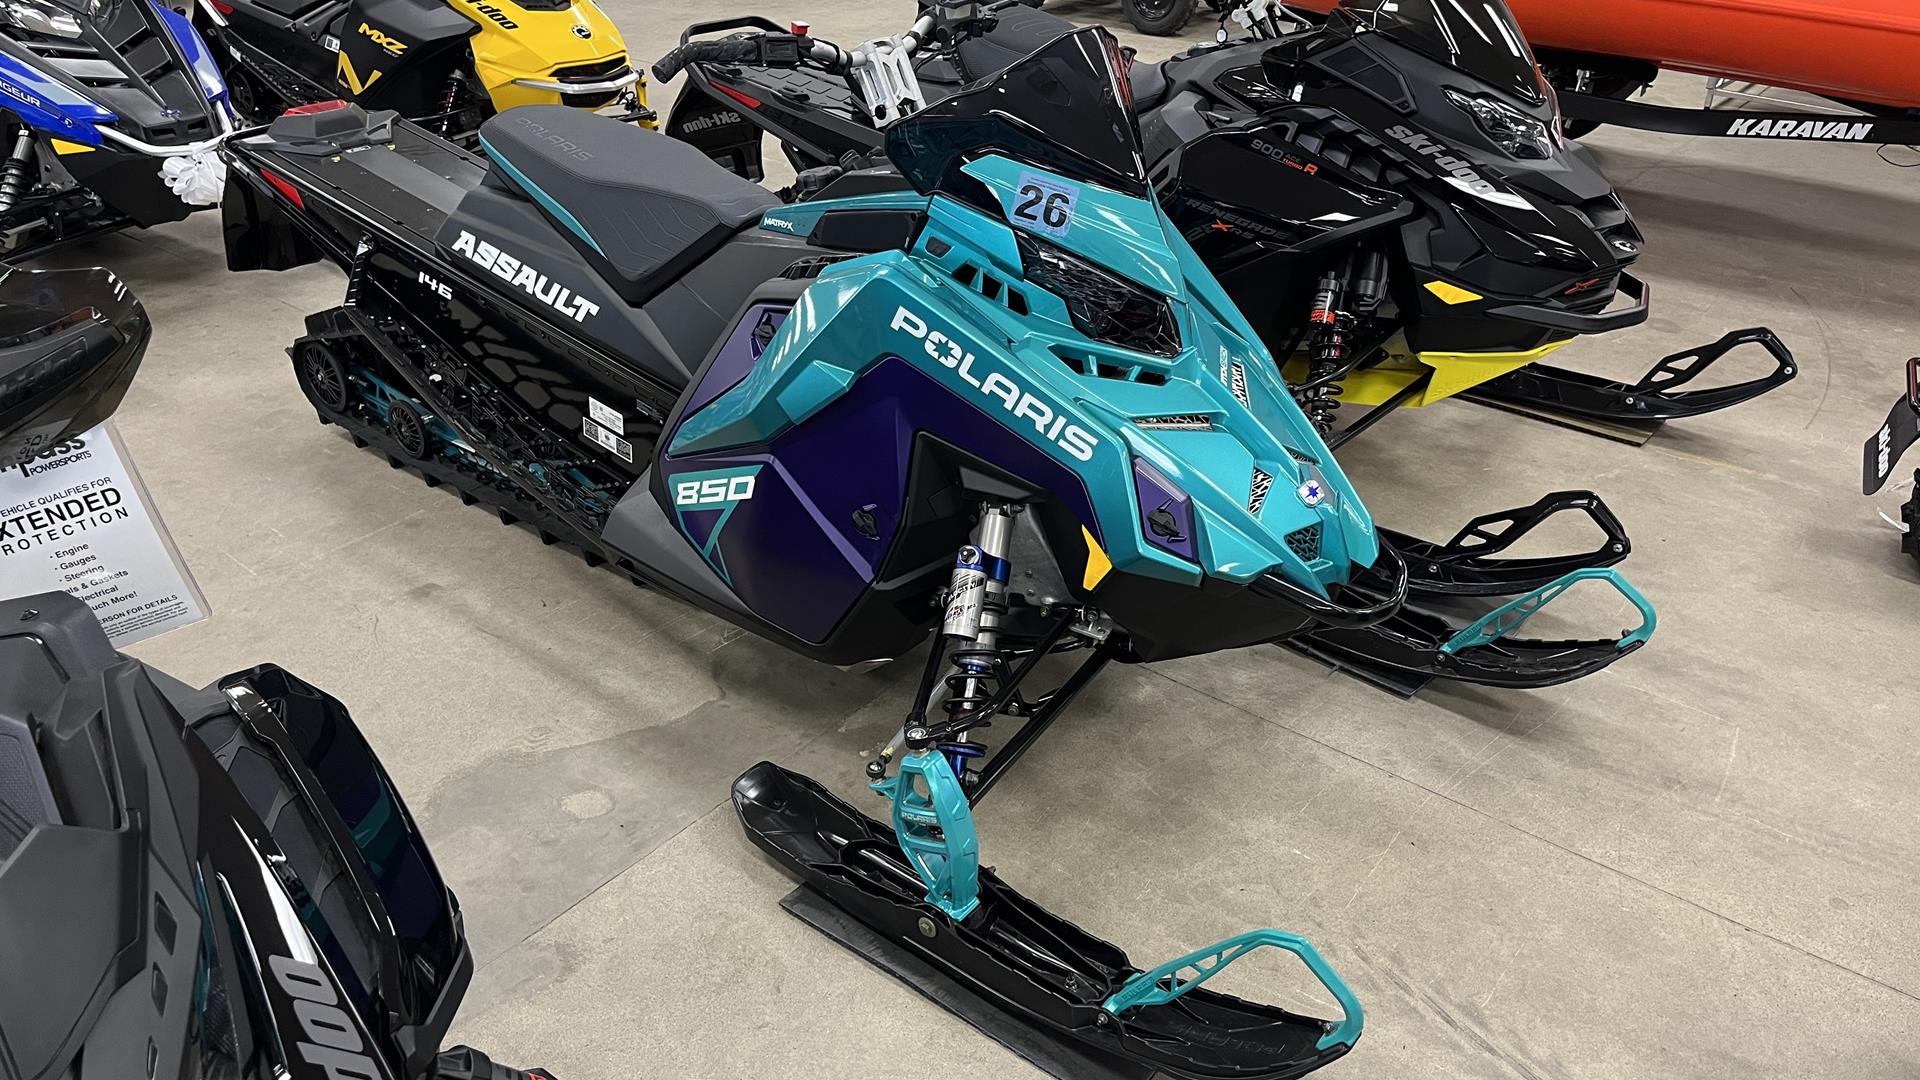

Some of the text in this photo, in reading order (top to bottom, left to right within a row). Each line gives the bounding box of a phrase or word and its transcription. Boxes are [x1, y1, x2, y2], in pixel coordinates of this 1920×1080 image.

[358, 22, 408, 55] MXZ
[0, 81, 41, 108] GEUR
[514, 117, 595, 162] POLARIS
[1726, 119, 1873, 140] KARAVAN
[1251, 139, 1284, 160] 900
[1303, 163, 1319, 175] R
[1014, 184, 1070, 228] 26
[1185, 198, 1290, 240] RENEGADE
[763, 216, 794, 232] MATRYX
[418, 271, 452, 300] 146
[451, 230, 600, 323] ASSAULT
[890, 305, 1099, 462] POLARIS
[29, 450, 92, 476] POWERSPORTS
[37, 482, 89, 506] QUALIFIES
[90, 476, 112, 490] FOR
[676, 475, 755, 505] 850
[55, 543, 89, 560] Engine
[60, 554, 97, 571] Gauges
[64, 564, 105, 583] Steering
[89, 569, 129, 587] Gaskets
[78, 585, 119, 602] lectrical
[109, 590, 138, 605] More!
[126, 605, 144, 616] FOR
[144, 594, 178, 610] DETAILS
